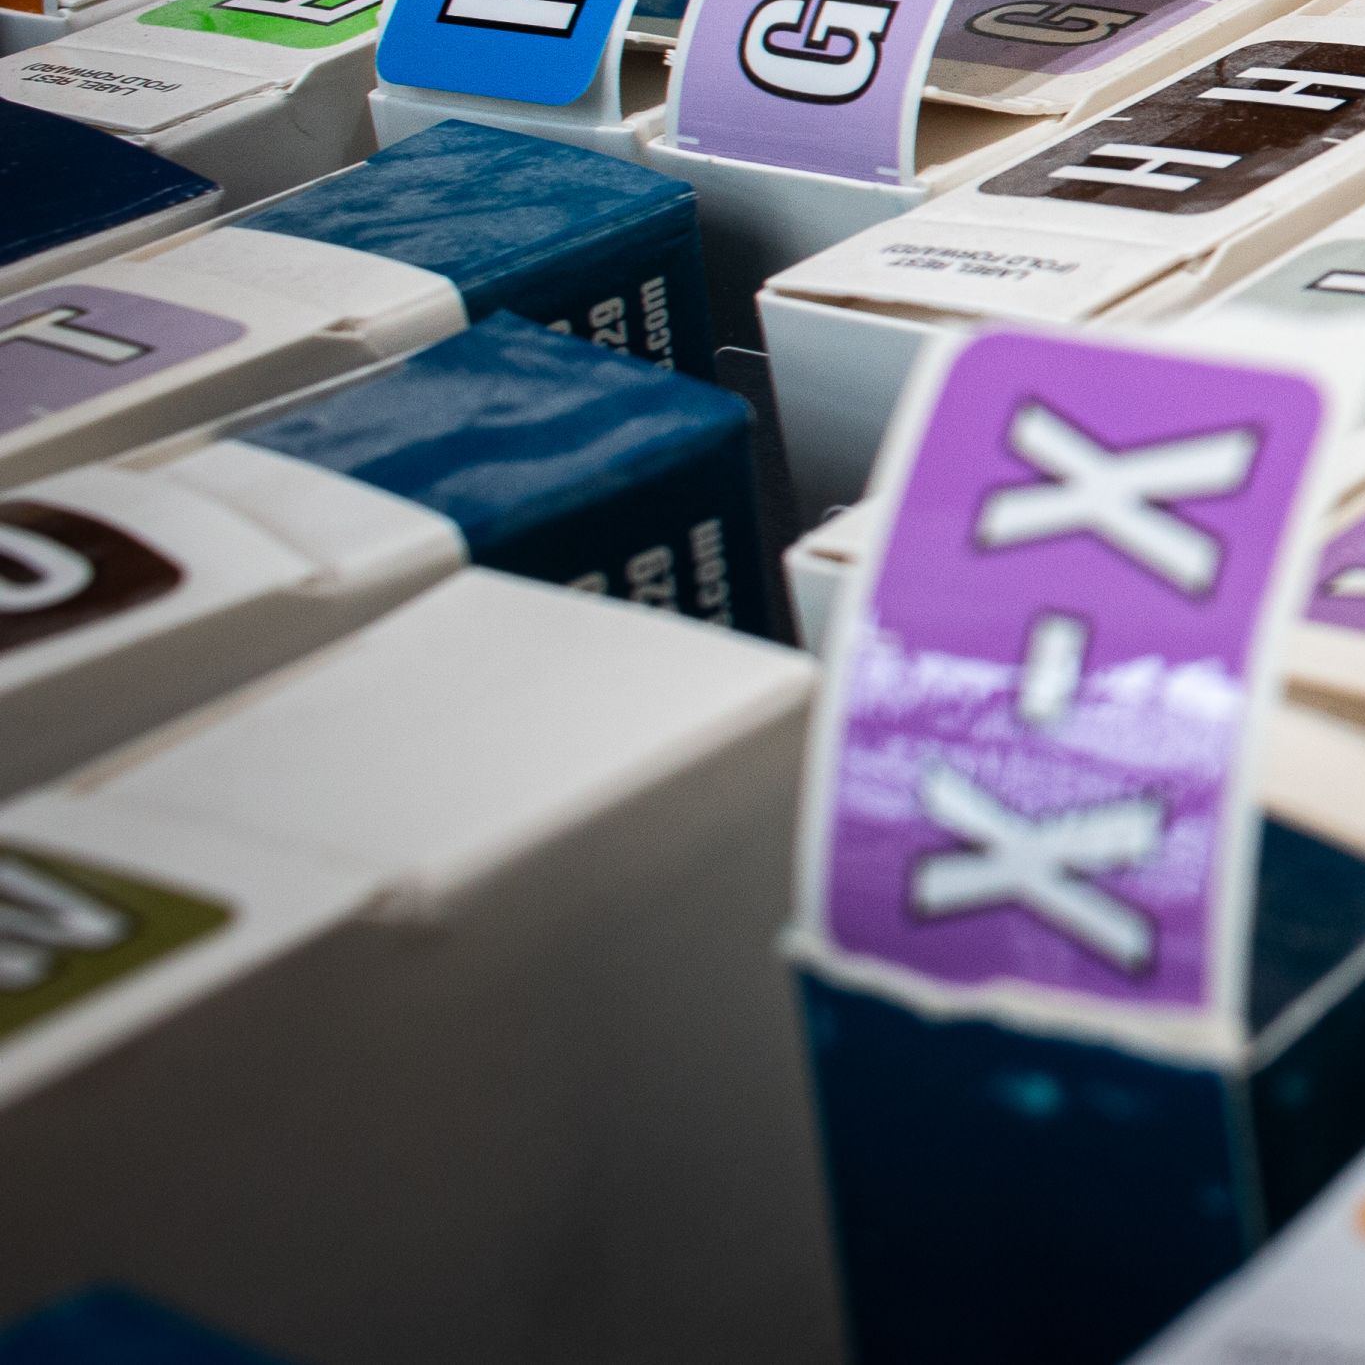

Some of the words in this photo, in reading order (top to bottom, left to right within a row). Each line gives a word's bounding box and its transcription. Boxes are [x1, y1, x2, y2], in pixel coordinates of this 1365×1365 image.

[965, 0, 1150, 47] G
[1048, 142, 1242, 193] H
[909, 390, 1270, 984] X-X
